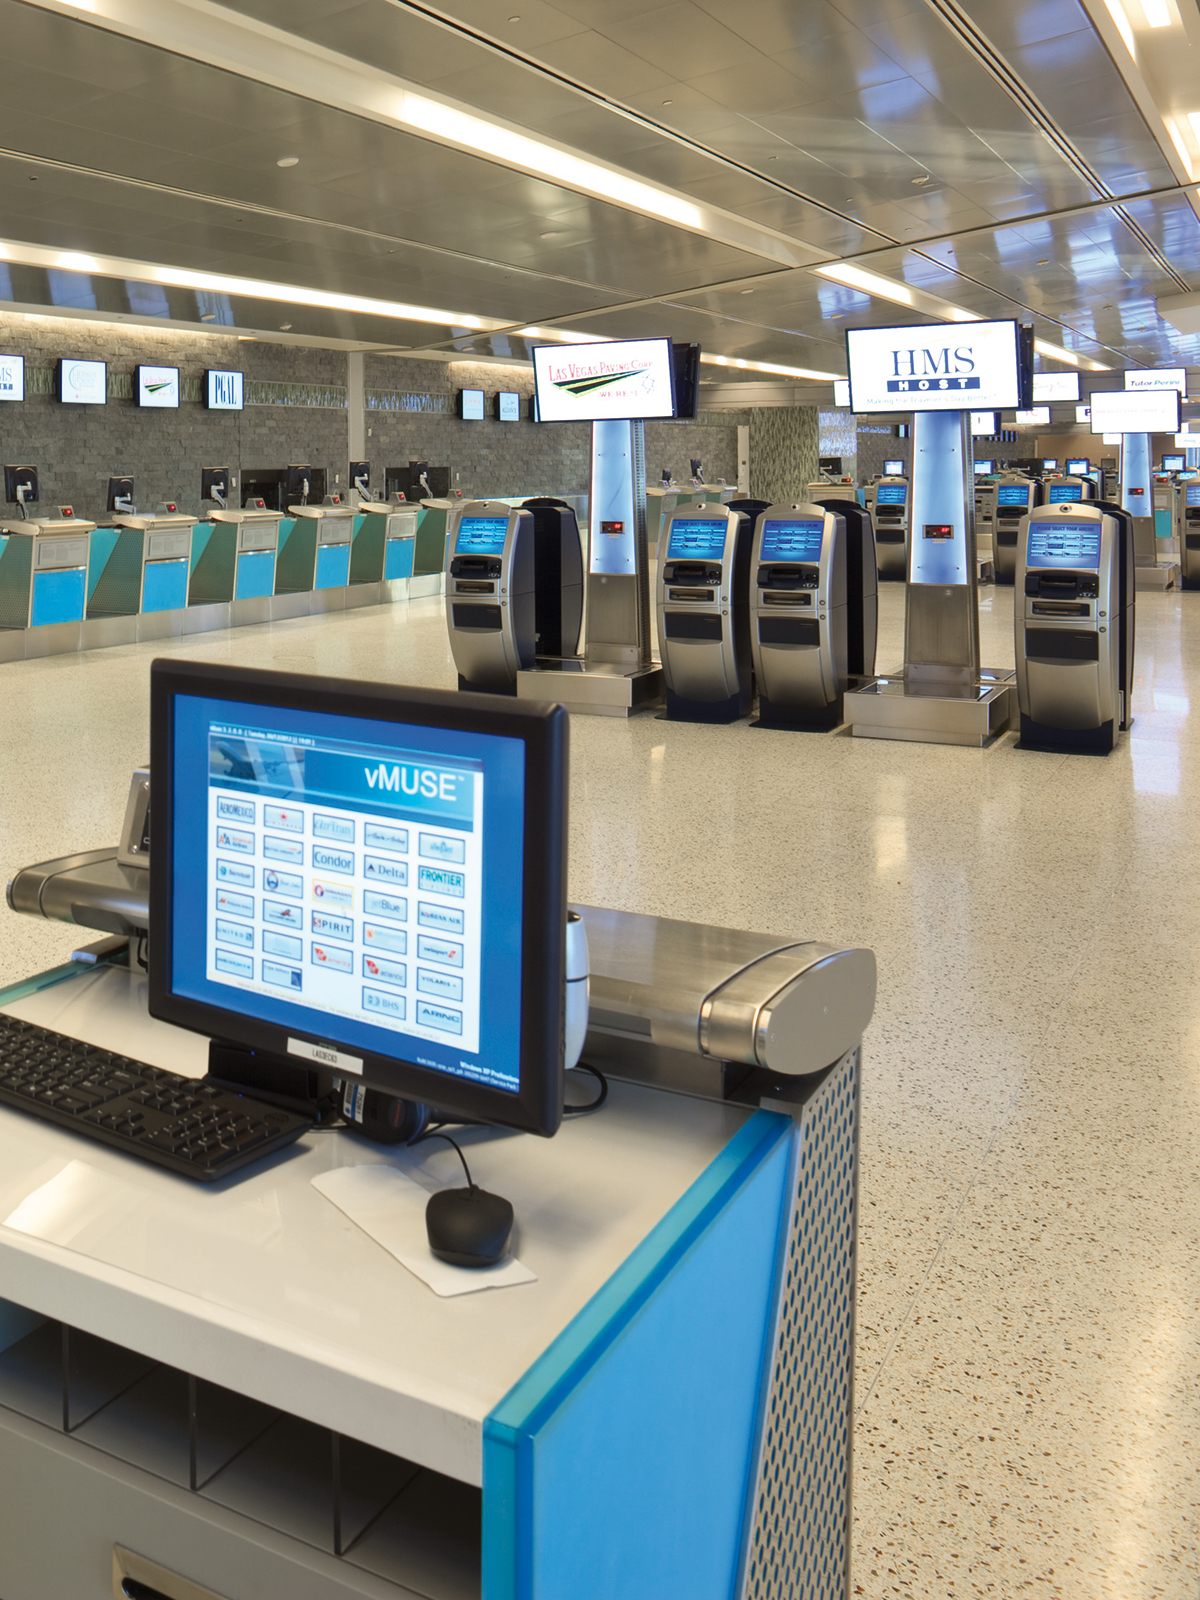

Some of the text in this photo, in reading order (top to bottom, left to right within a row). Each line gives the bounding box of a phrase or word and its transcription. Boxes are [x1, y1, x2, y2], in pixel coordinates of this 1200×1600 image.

[890, 346, 975, 376] HMS
[548, 365, 568, 381] LAS
[568, 363, 599, 378] VEGAS
[600, 361, 630, 374] PAVING
[215, 374, 237, 405] PGAL
[899, 378, 968, 391] HOST
[220, 801, 253, 818] AEROMEXICO
[314, 850, 352, 869] Condor
[378, 863, 405, 879] Delta
[420, 868, 462, 887] FRONTIER
[216, 927, 245, 939] UNITED
[312, 916, 351, 934] SPIRIT
[382, 998, 400, 1011] BHS
[422, 1008, 460, 1023] ARINC
